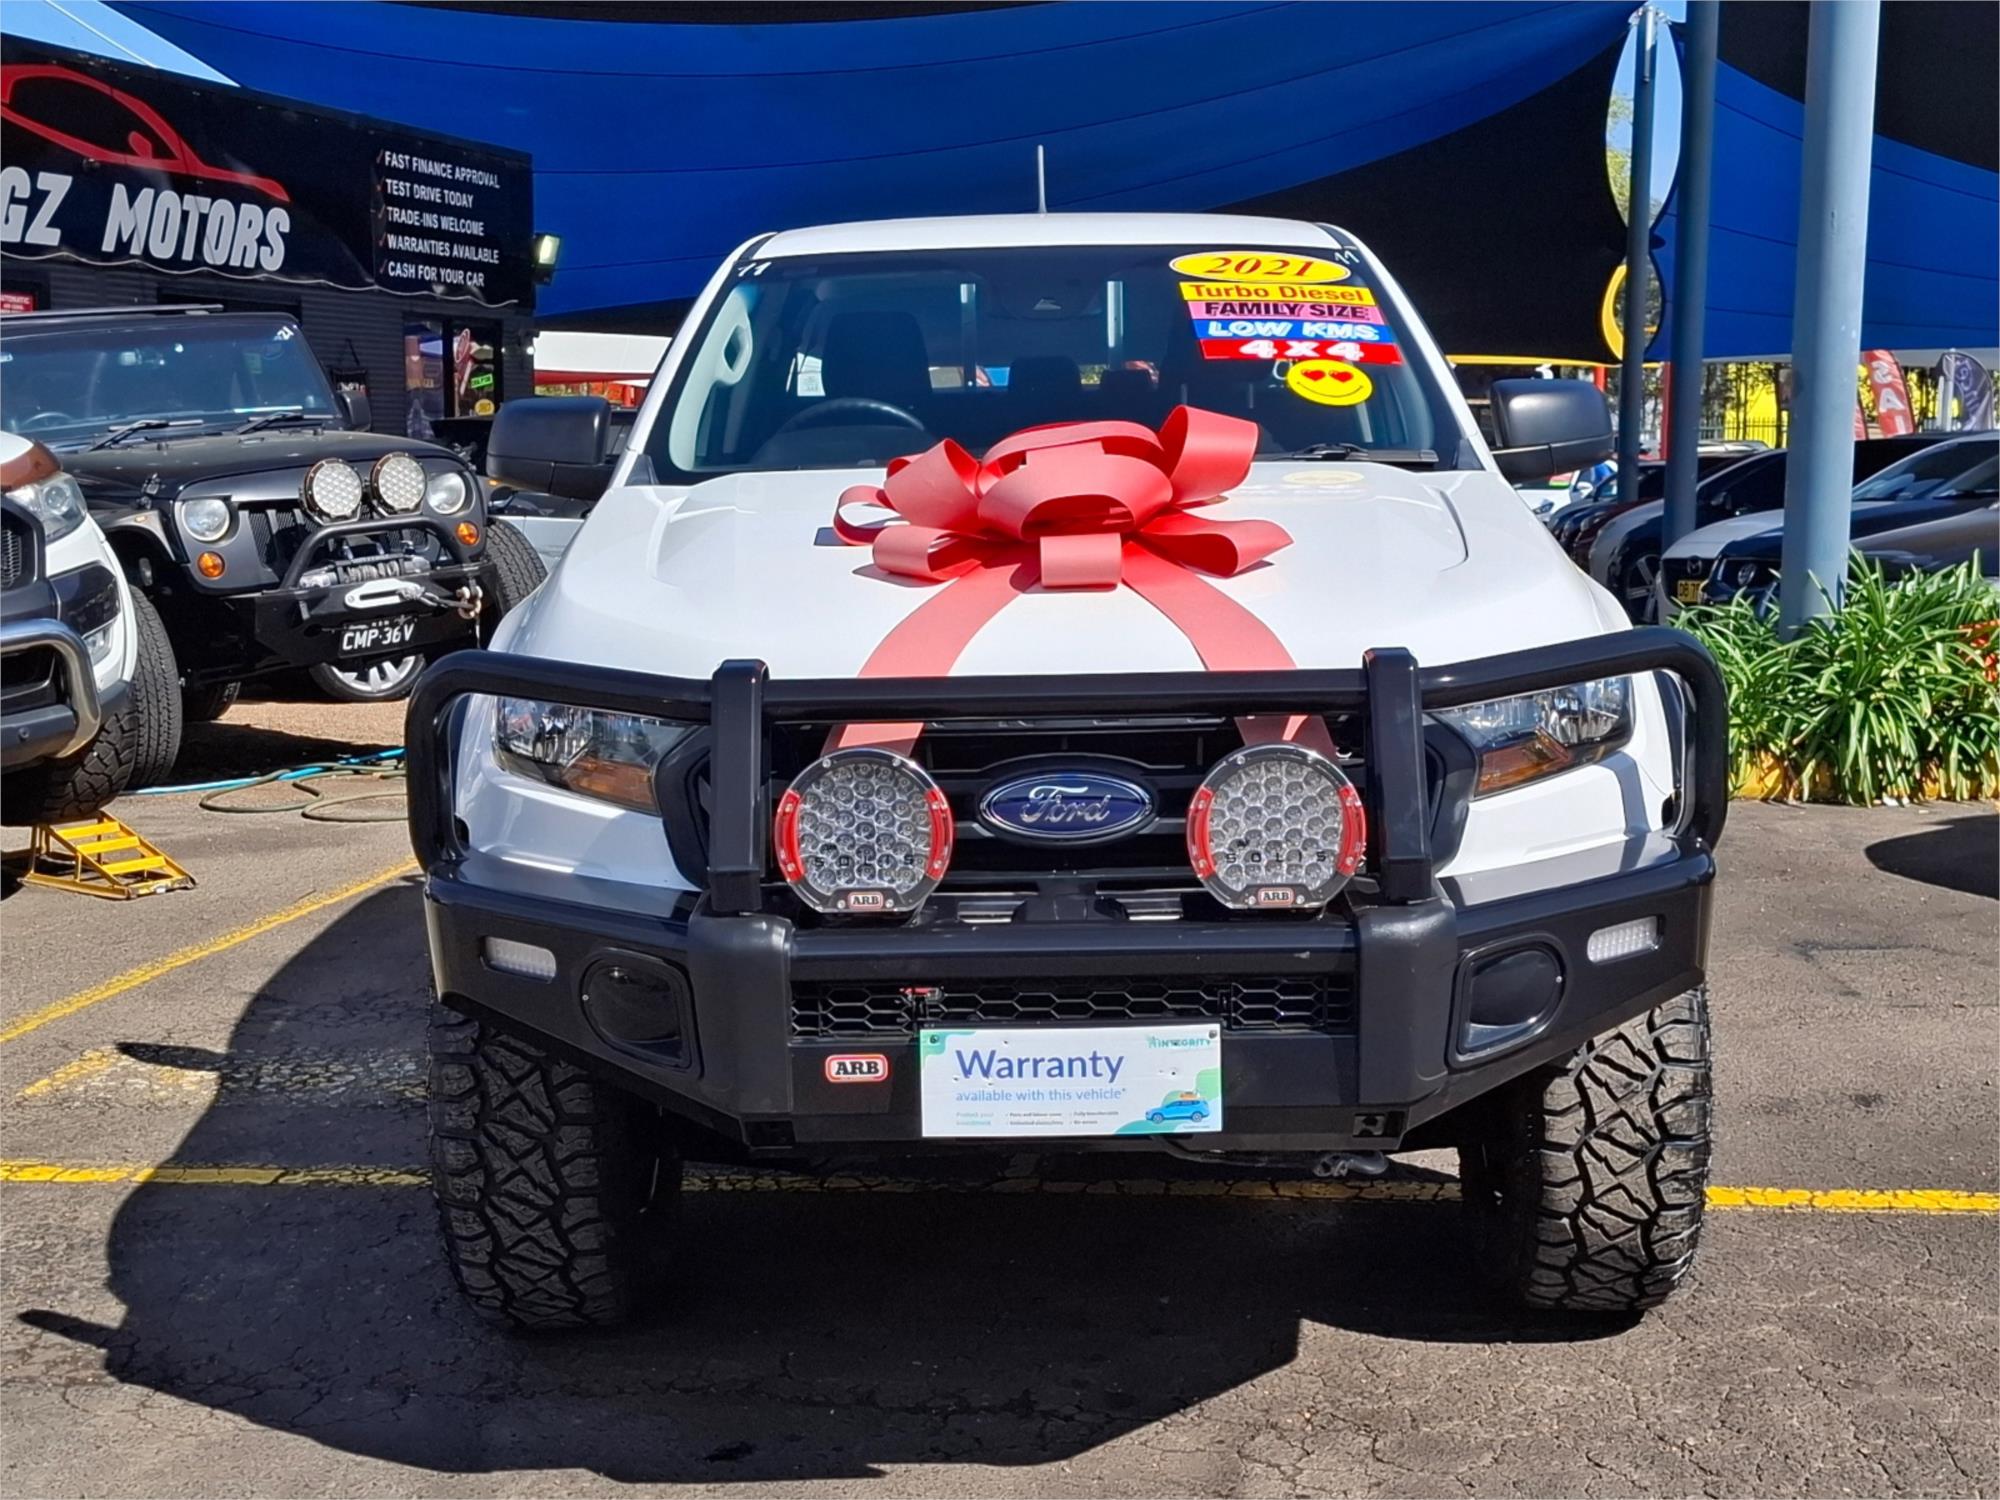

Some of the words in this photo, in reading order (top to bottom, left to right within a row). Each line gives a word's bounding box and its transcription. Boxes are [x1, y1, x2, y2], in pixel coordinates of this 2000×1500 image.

[384, 150, 411, 169] FAST
[412, 157, 453, 179] FINANCE
[454, 166, 500, 188] APPROVAL
[385, 179, 411, 197] TEST
[413, 184, 442, 203] DRIVE
[443, 189, 474, 208] TODAY
[101, 183, 291, 271] MOTORS
[387, 206, 439, 229] TRADE-INS
[440, 215, 485, 236] WELCOME
[387, 233, 450, 256] WARRANTIES
[452, 243, 500, 264] AVAILABLE
[387, 261, 416, 279] CASH
[418, 265, 437, 281] FOR
[439, 268, 465, 284] YOUR
[466, 271, 485, 287] CAR
[1205, 257, 1315, 277] 2021
[1190, 284, 1270, 299] Turbo
[1279, 286, 1364, 301] Diesel
[1205, 302, 1305, 317] FAMILY
[1310, 304, 1370, 320] SIZE
[1208, 321, 1293, 336] LOW
[1302, 323, 1380, 340] KMS
[1020, 786, 1111, 823] Ford
[852, 895, 880, 906] ARB
[1262, 892, 1290, 902] ARB
[835, 1060, 880, 1076] ARB
[955, 1049, 1125, 1083] Warranty
[955, 1089, 1012, 1101] available
[1016, 1088, 1046, 1101] with
[1050, 1088, 1072, 1100] this
